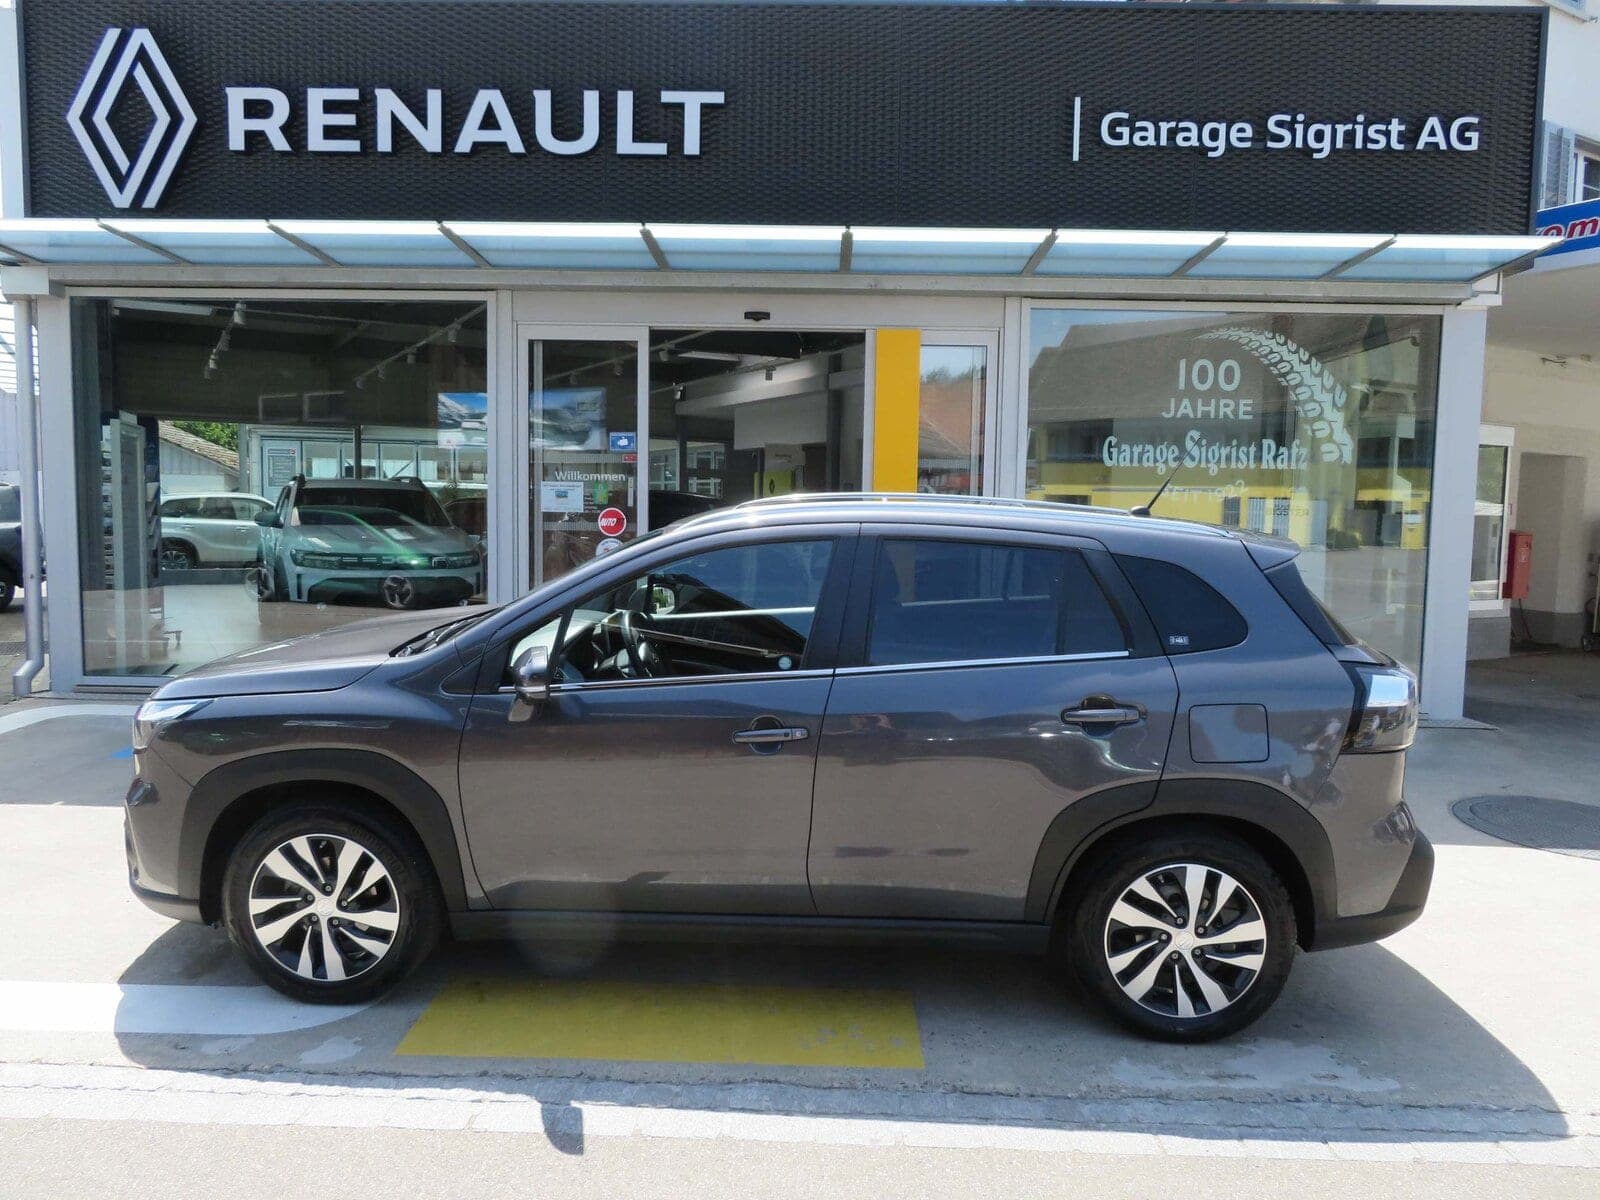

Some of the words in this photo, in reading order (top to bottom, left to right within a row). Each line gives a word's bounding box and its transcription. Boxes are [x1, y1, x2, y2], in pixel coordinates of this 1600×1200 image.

[225, 87, 725, 155] RENAULT
[1101, 111, 1253, 158] Garage
[1266, 113, 1406, 159] Sigrist
[1416, 116, 1480, 151] AG
[1178, 358, 1241, 392] 100
[1161, 397, 1254, 420] JAHRE
[1102, 436, 1179, 475] Garage
[1184, 429, 1256, 476] Sigrist
[1261, 438, 1308, 470] Rafz
[555, 470, 626, 482] Willkommen
